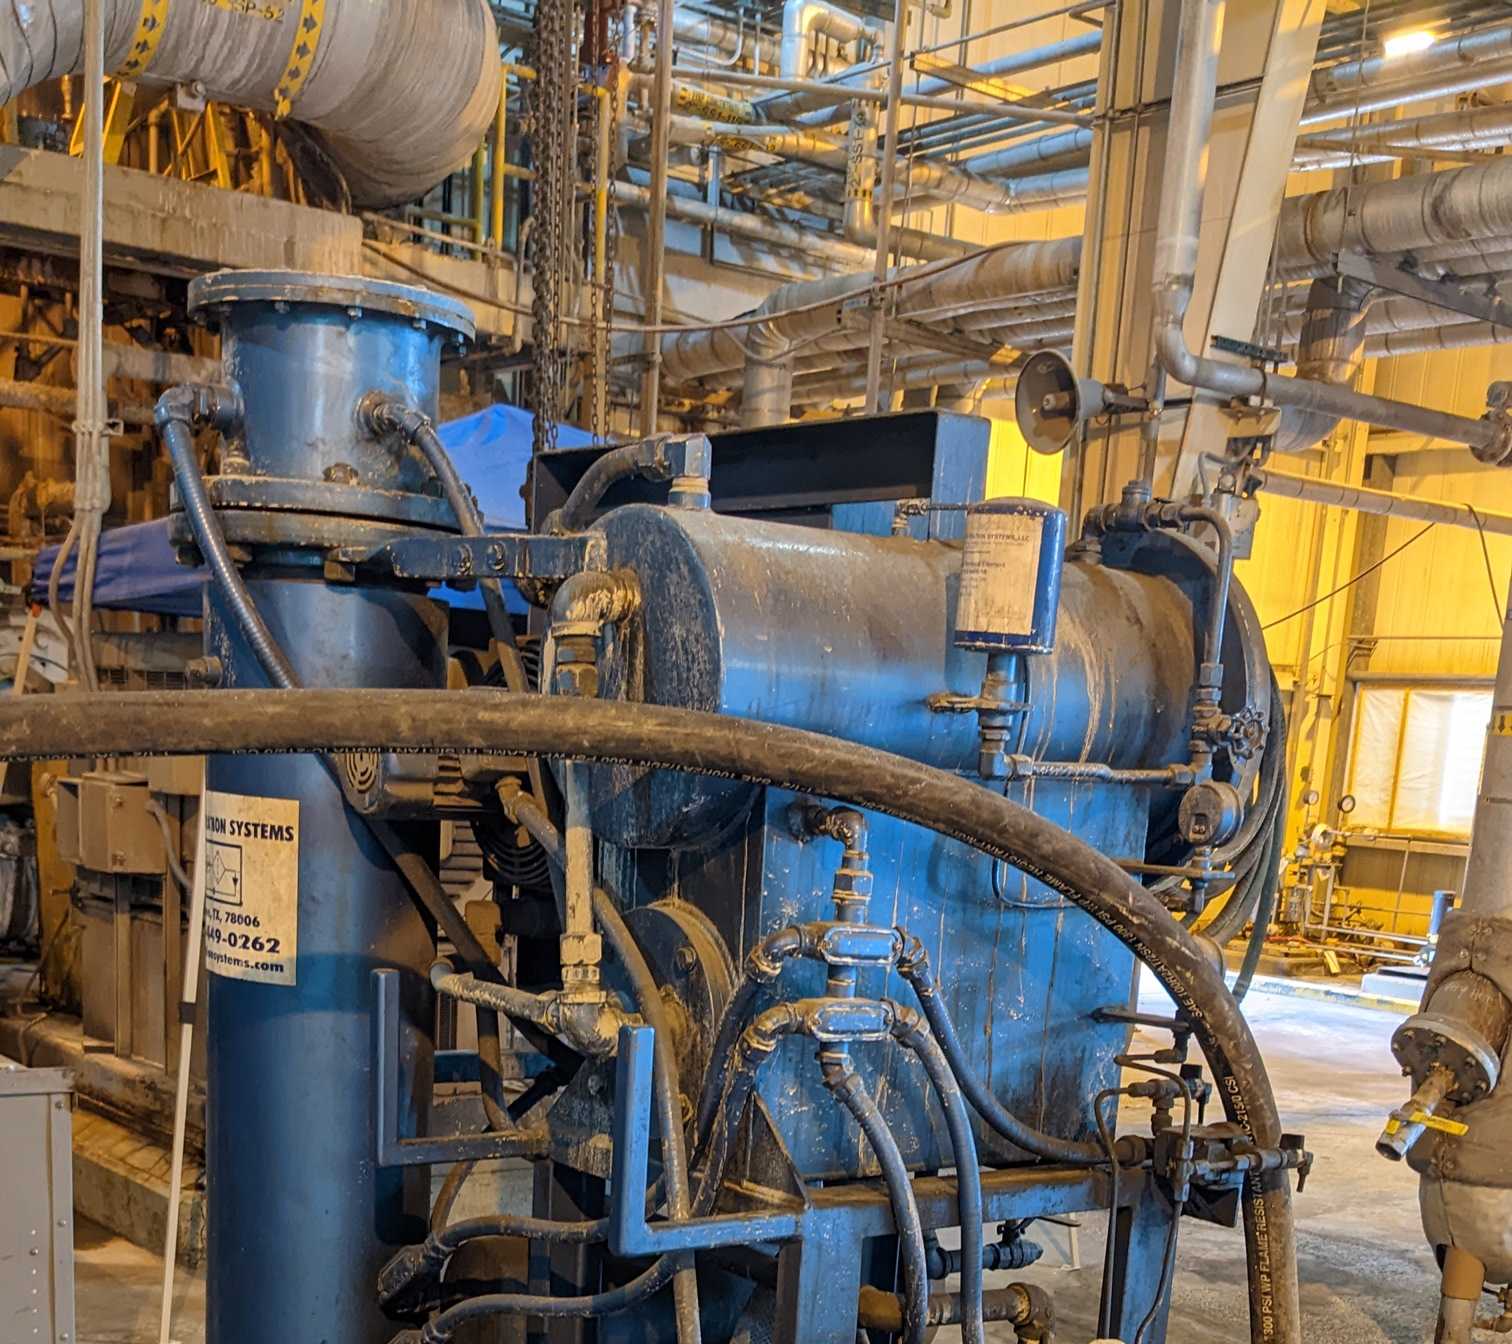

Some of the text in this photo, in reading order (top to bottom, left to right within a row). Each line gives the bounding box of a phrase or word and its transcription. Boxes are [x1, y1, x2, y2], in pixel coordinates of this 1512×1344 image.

[229, 819, 294, 842] SYSTEMS
[225, 911, 260, 928] 78006
[1225, 1076, 1239, 1095] CSI
[1257, 1231, 1270, 1273] FLAME
[1260, 1273, 1273, 1294] WP
[1262, 1295, 1273, 1313] PSI
